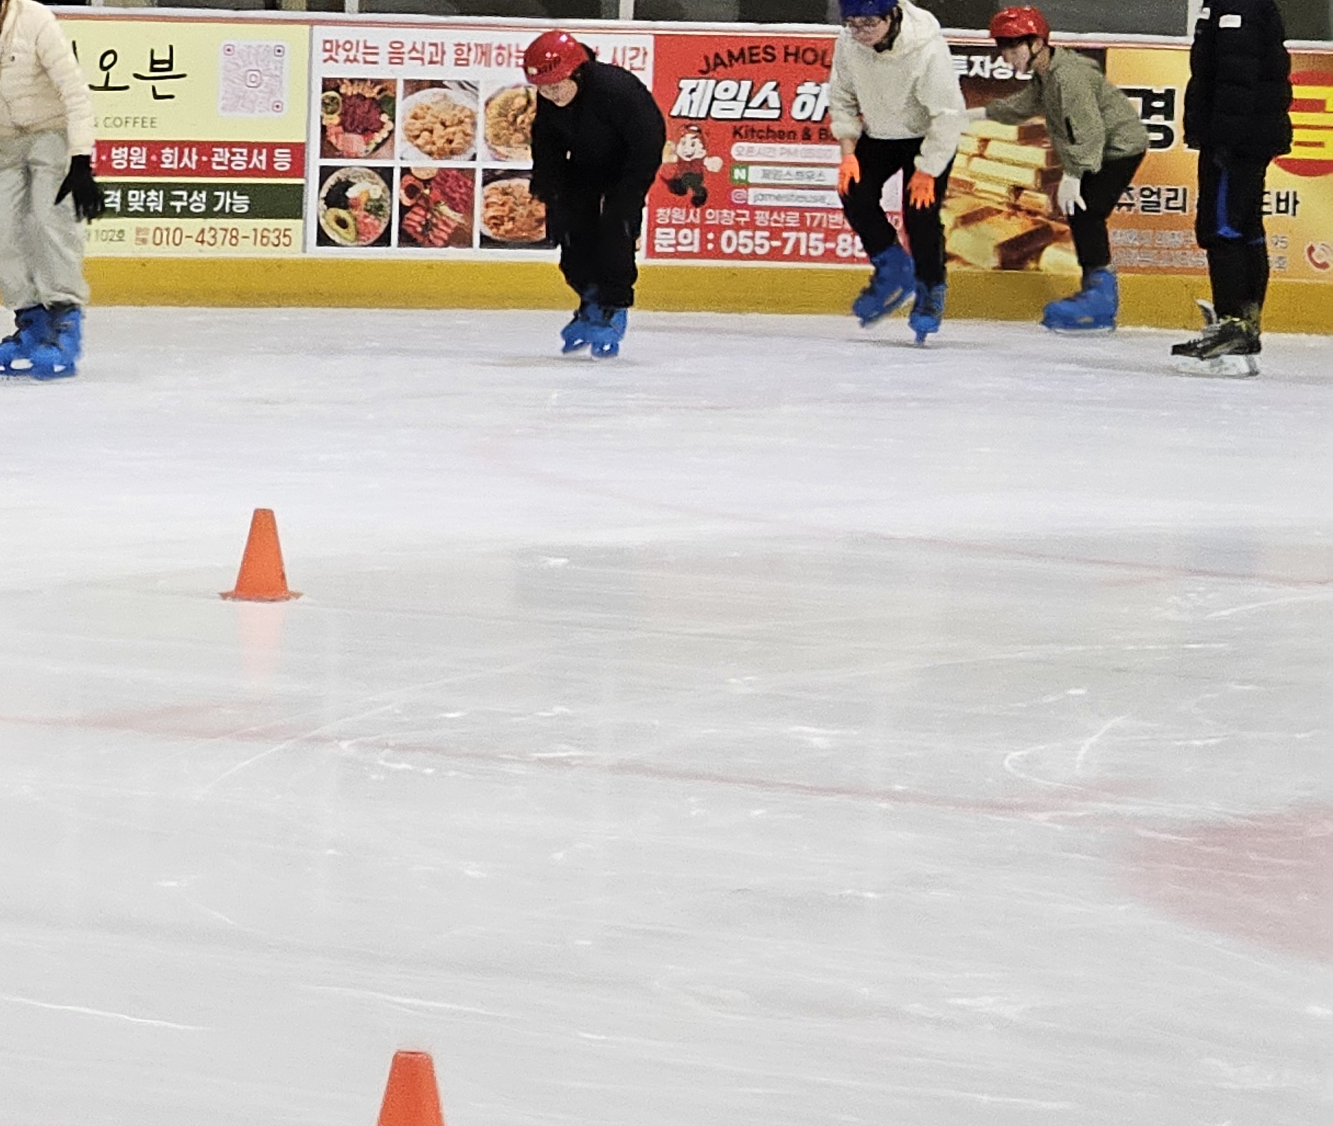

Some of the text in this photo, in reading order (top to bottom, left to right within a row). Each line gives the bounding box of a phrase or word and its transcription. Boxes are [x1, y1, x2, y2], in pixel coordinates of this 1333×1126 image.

[322, 38, 380, 65] 맛있는
[387, 39, 446, 66] 음식과
[611, 45, 649, 71] 시간
[698, 44, 777, 75] JAMES
[72, 40, 188, 101] 오븐
[670, 78, 831, 122] 제임스 하
[103, 116, 158, 129] COFFEE
[733, 125, 797, 141] Kitchen
[801, 125, 812, 141] &
[111, 146, 293, 171] 병원 회사 관공서 등
[128, 189, 164, 213] 맞춰
[170, 190, 208, 213] 구성
[213, 190, 251, 213] 가능
[1259, 190, 1301, 217] 드바
[655, 207, 701, 224] 창원시
[704, 209, 750, 226] 의창구
[152, 226, 293, 247] 010-4378-1635
[654, 228, 701, 253] 문의
